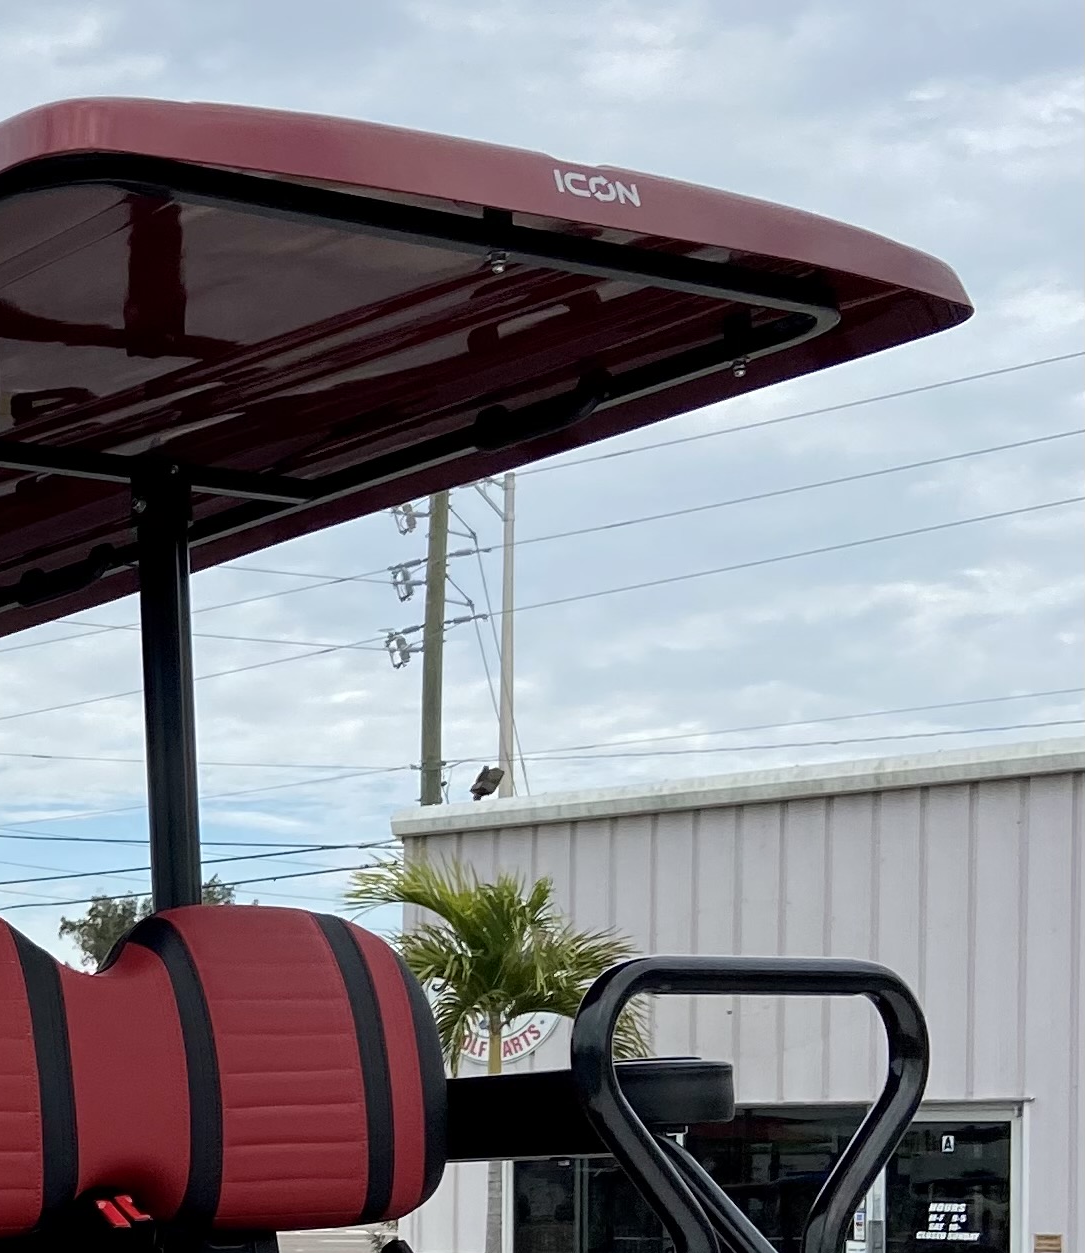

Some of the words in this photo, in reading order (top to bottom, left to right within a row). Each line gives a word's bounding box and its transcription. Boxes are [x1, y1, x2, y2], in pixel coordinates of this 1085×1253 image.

[553, 169, 642, 208] ICON
[462, 1034, 488, 1058] OLF
[502, 1023, 541, 1058] ARTS
[943, 1135, 953, 1151] A
[928, 1202, 967, 1213] HOURS
